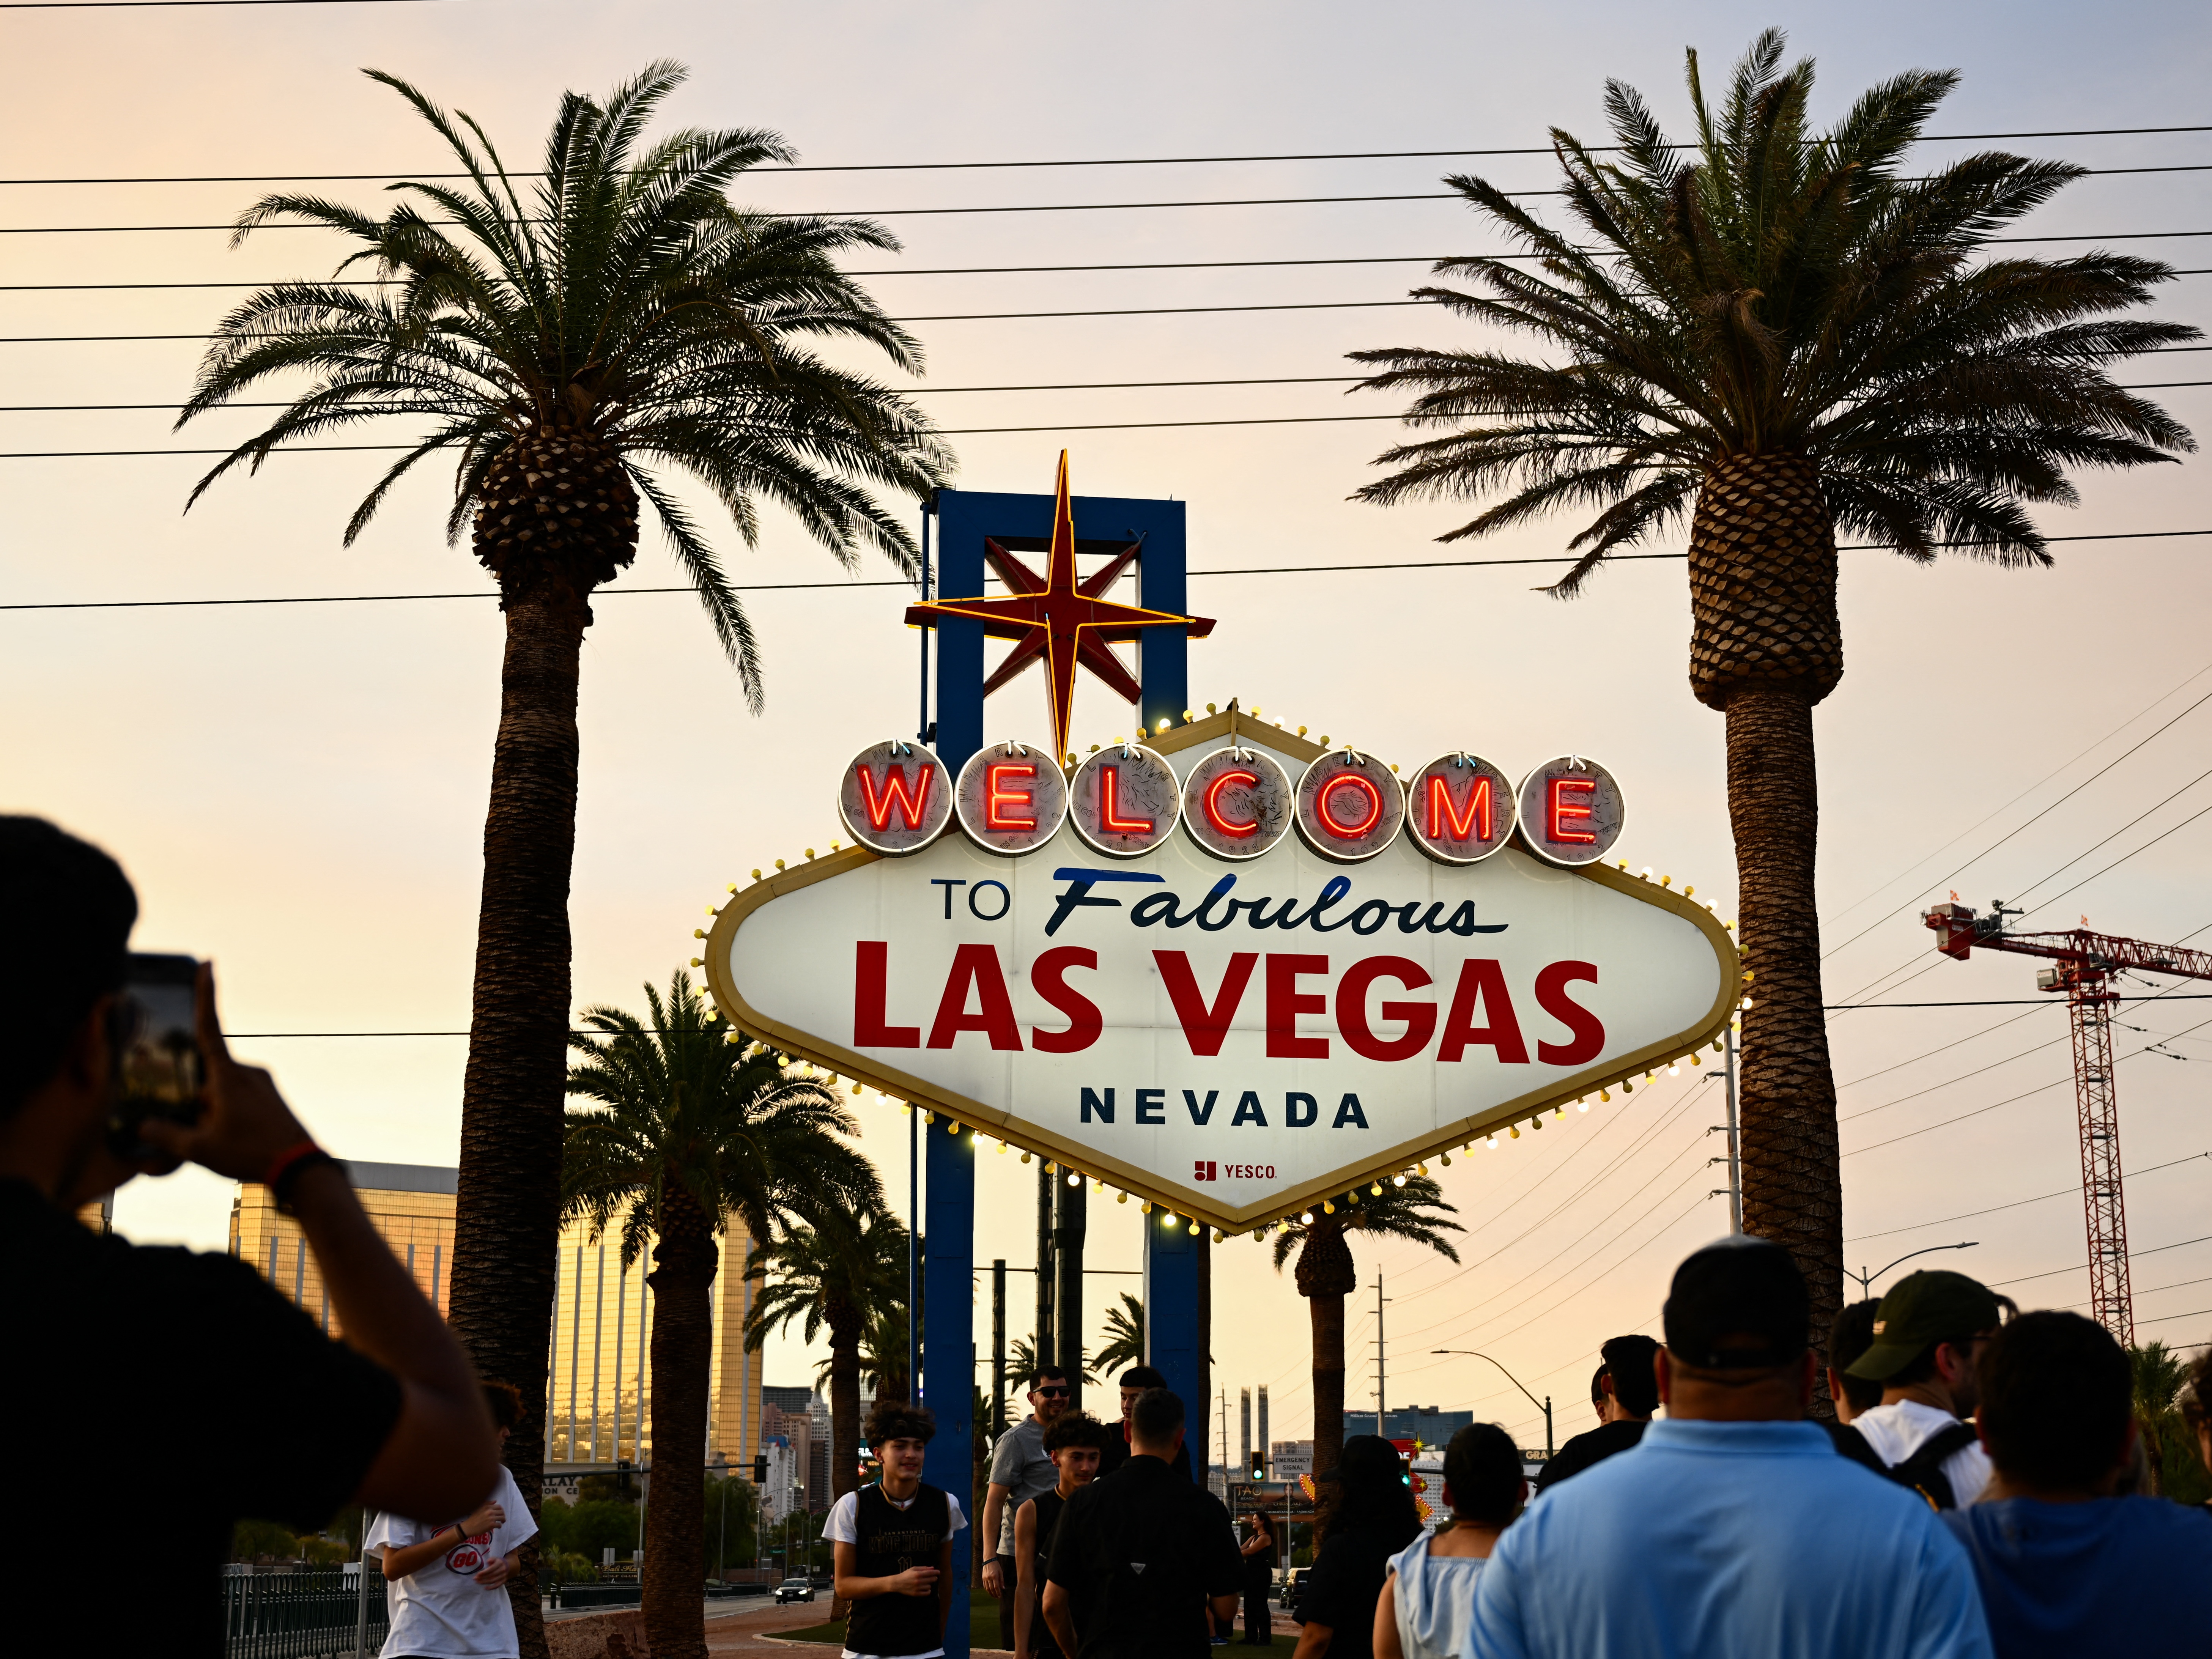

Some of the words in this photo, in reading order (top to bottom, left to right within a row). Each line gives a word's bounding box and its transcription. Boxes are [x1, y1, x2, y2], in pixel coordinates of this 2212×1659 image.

[855, 762, 1596, 844] WELCOME
[1129, 834, 1151, 849] TRUST
[1218, 842, 1260, 856] 1922
[931, 878, 1011, 921] TO
[1045, 867, 1508, 937] Fabulous
[853, 941, 1103, 1054] LAS
[1152, 949, 1606, 1067] VEGAS
[1080, 1087, 1369, 1129] NEVADA
[1224, 1165, 1275, 1179] YESCO
[1235, 1486, 1262, 1496] TAO
[869, 1535, 900, 1554] KING
[902, 1533, 939, 1552] HOOPS
[453, 1551, 477, 1568] GO
